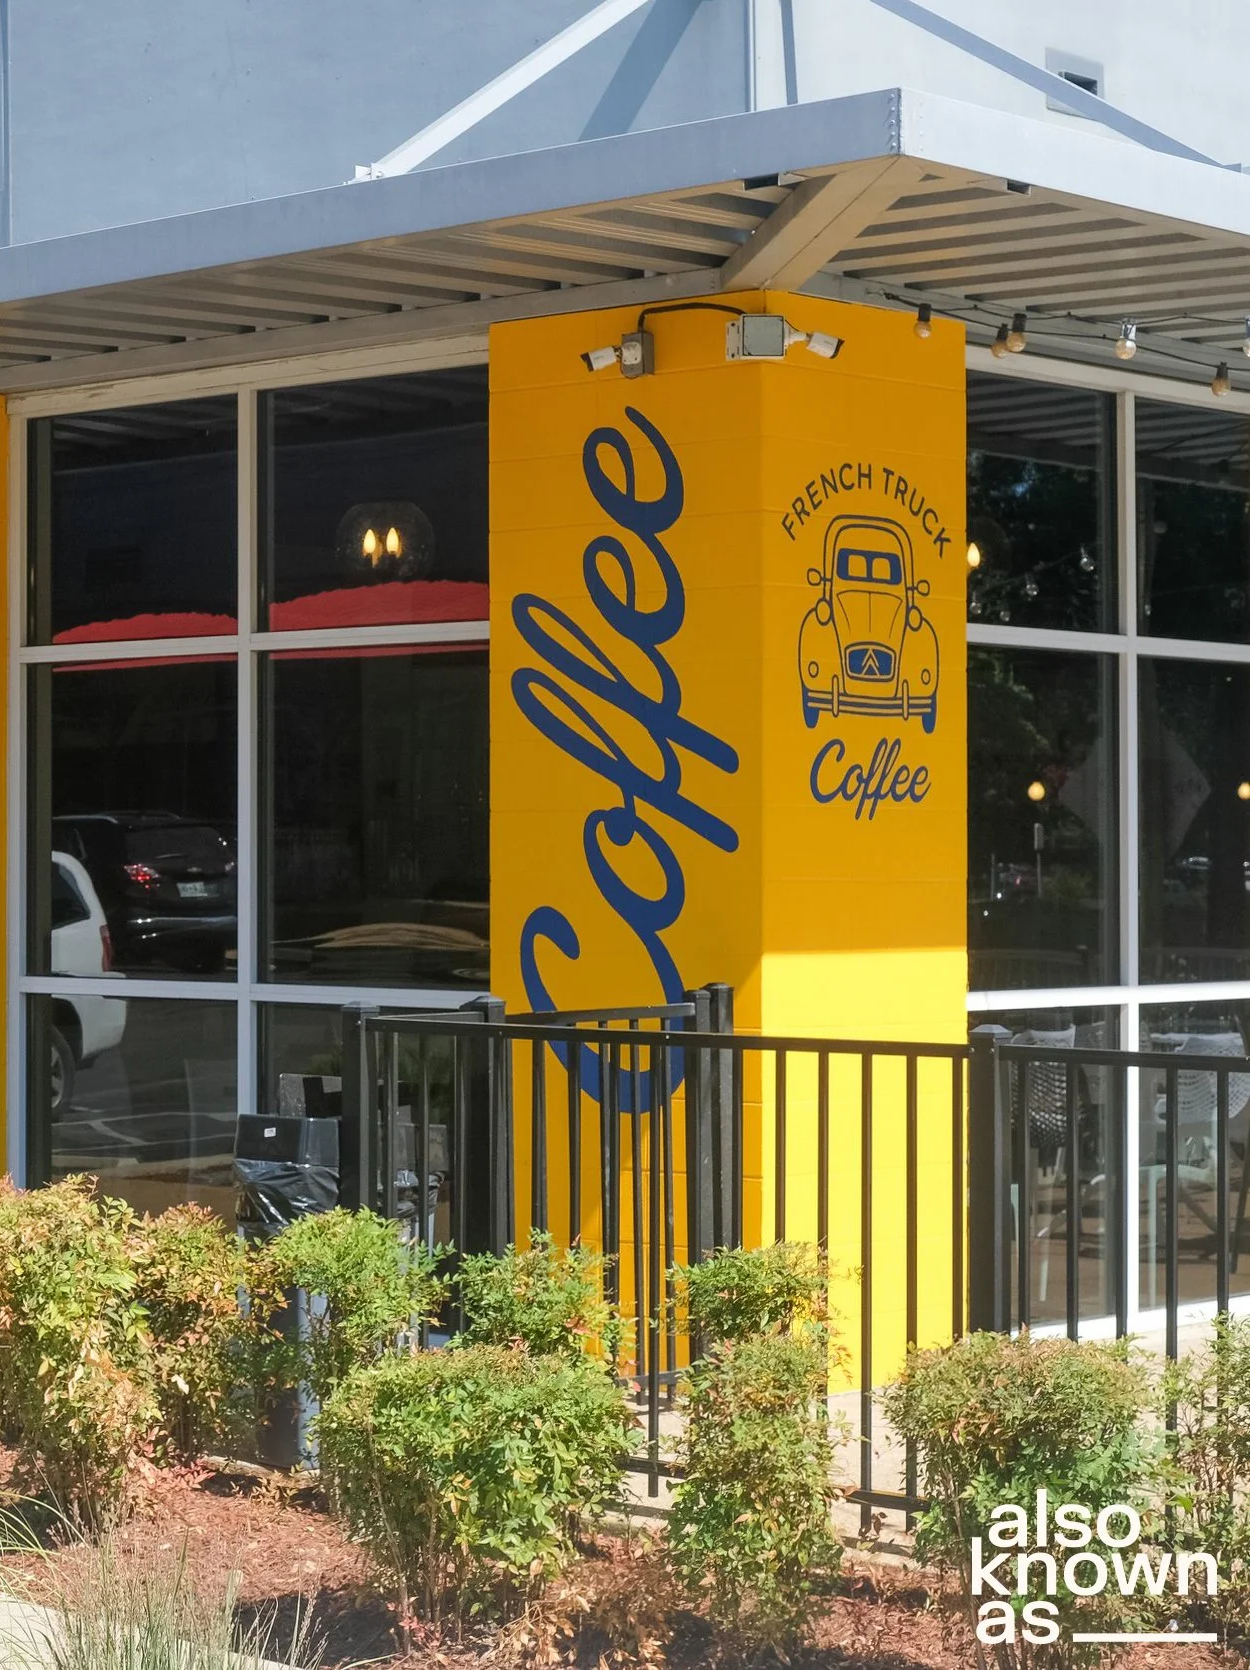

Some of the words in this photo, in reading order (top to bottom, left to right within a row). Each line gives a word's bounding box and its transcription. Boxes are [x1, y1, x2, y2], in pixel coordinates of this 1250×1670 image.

[781, 462, 872, 541] FRENCH
[882, 467, 952, 559] TRUCK
[511, 406, 740, 1114] Coffee
[810, 738, 932, 821] Coffee
